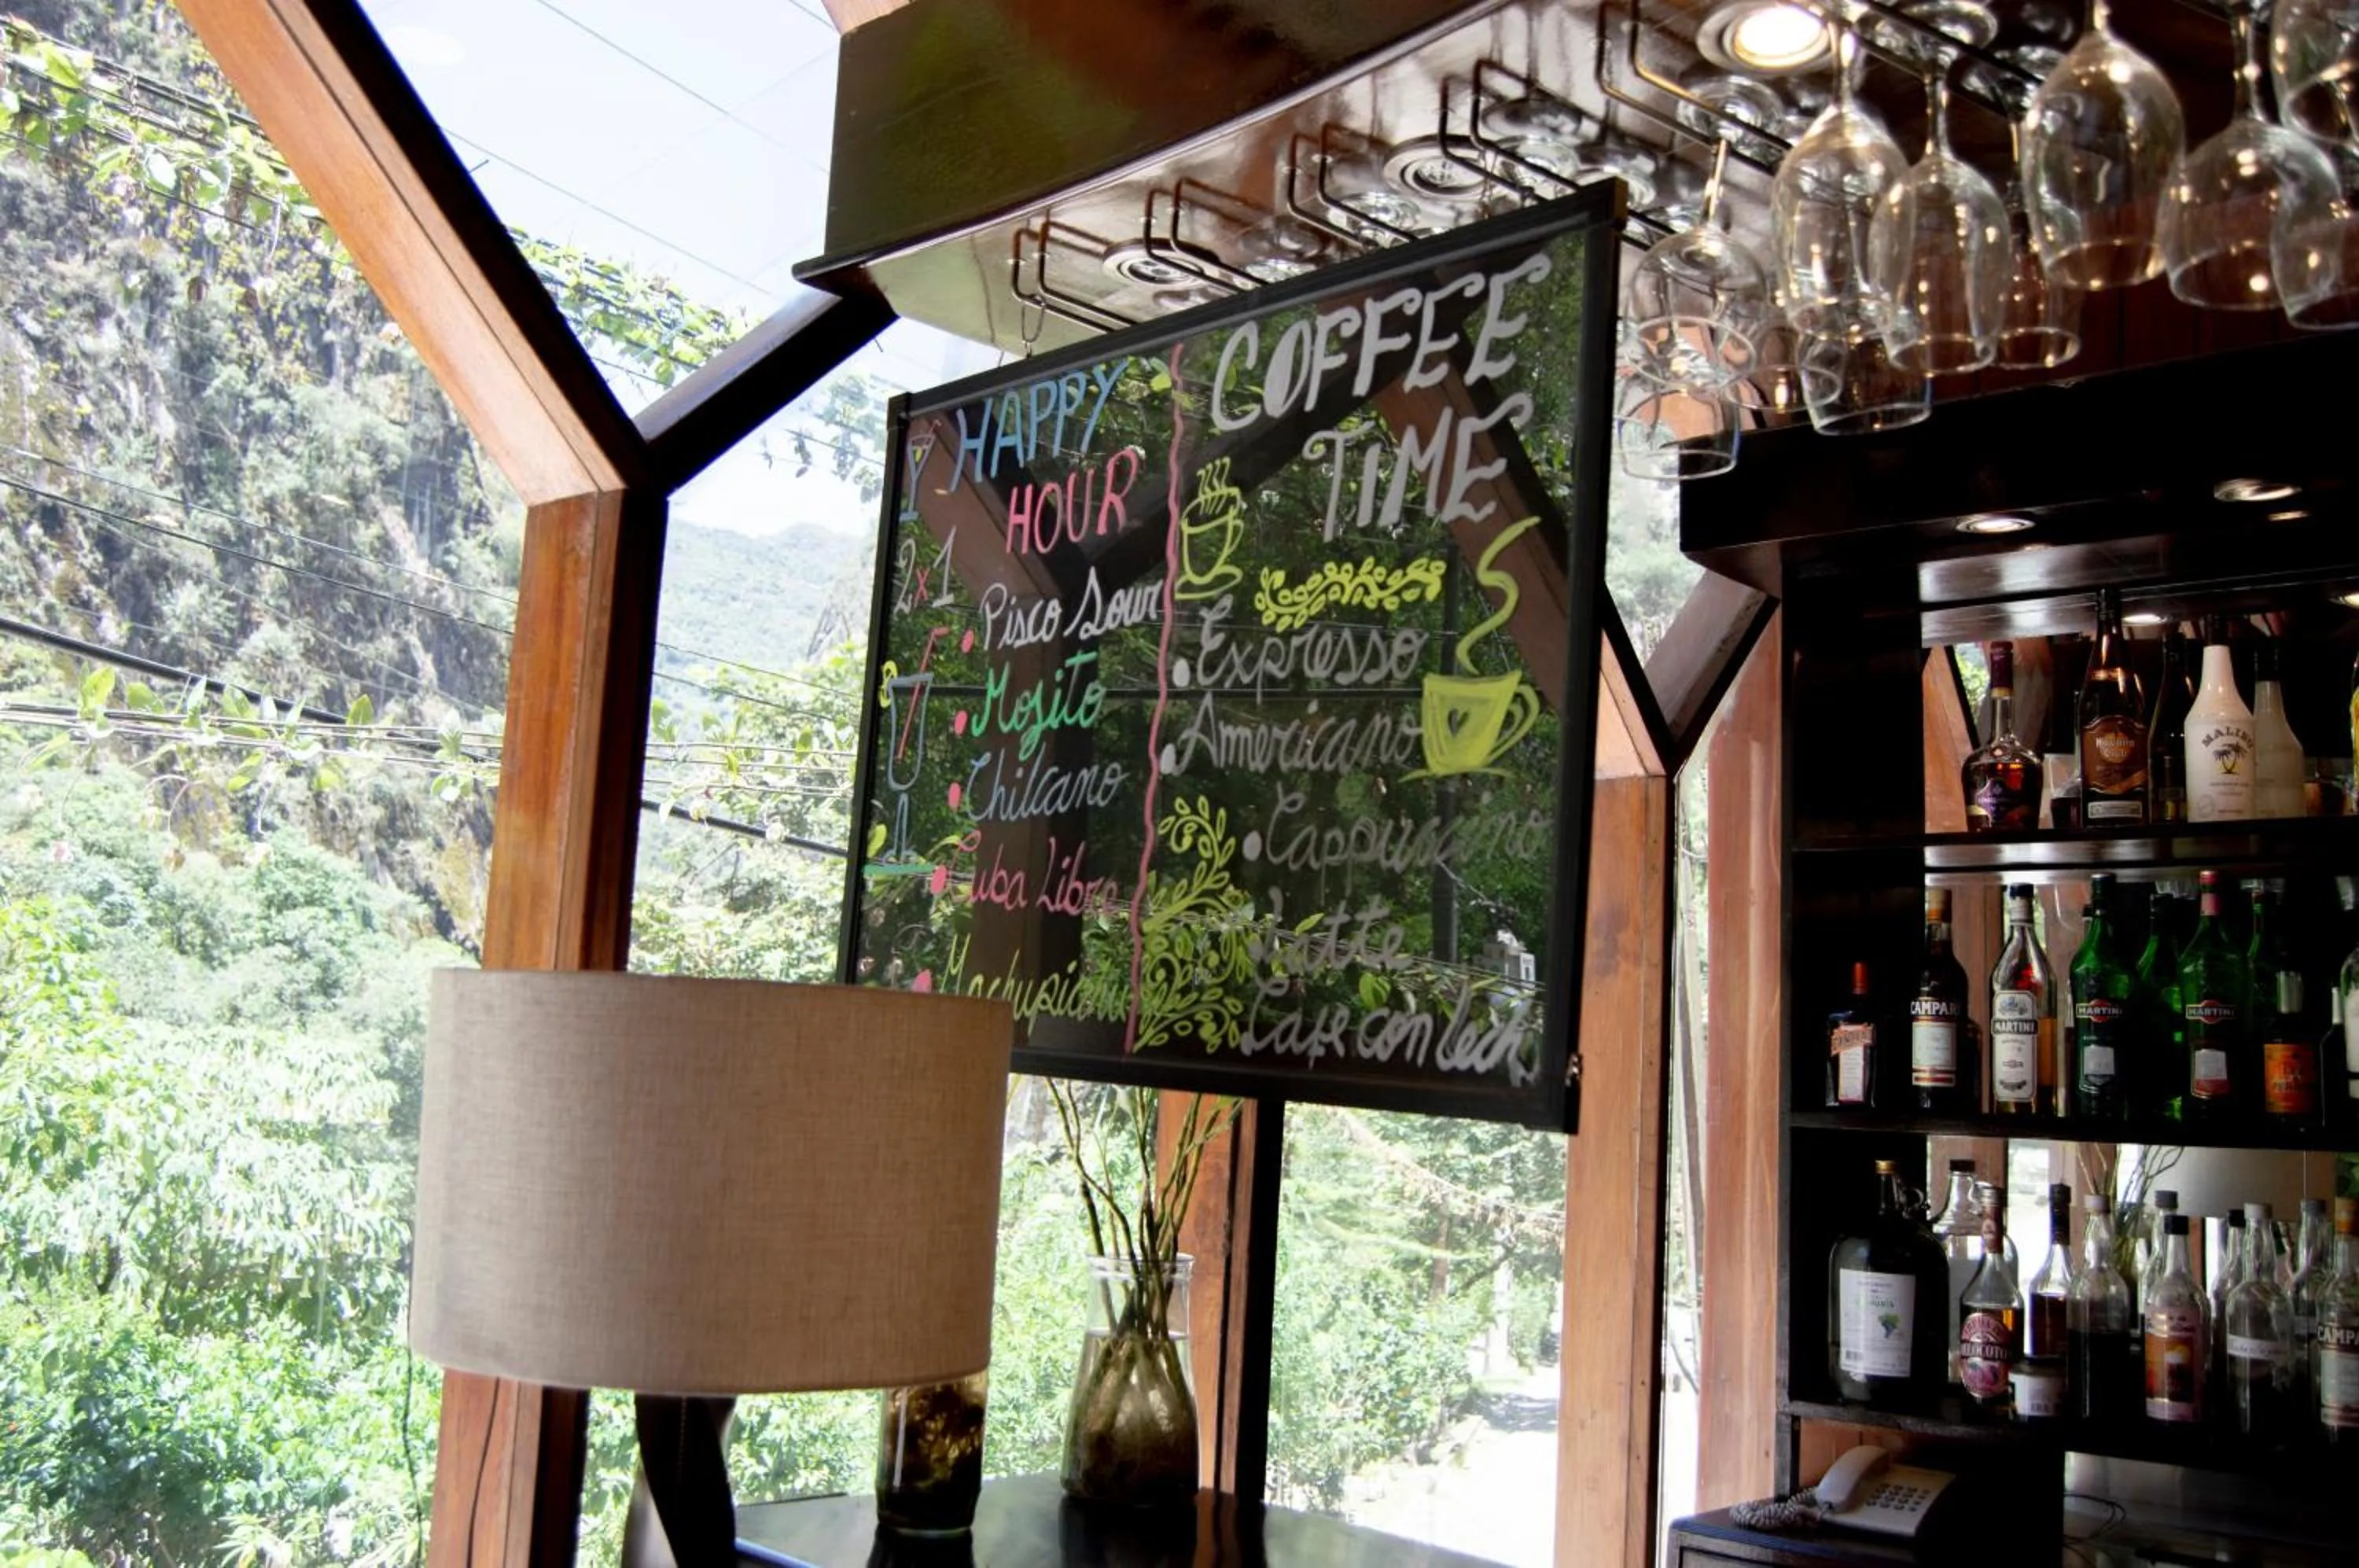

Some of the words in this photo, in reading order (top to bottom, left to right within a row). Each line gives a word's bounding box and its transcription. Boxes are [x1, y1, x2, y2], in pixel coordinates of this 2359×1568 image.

[1212, 252, 1553, 432] COFFEE
[949, 358, 1129, 492] HAPPY
[1302, 392, 1534, 543] TIME
[1006, 445, 1140, 554] HOUR
[980, 583, 1062, 651] Pisco
[1063, 566, 1163, 639] Sour
[1196, 593, 1429, 705] Expresso
[971, 650, 1106, 762] Mojito
[1176, 690, 1424, 775] Americano
[2201, 726, 2254, 749] MALIBU
[966, 743, 1130, 823] Chilcano
[948, 830, 1029, 911] Cuba
[1035, 835, 1121, 917] Libre
[1357, 1007, 1434, 1068] con
[1993, 1021, 2035, 1032] MARTINI
[2188, 1006, 2235, 1017] MARTINI
